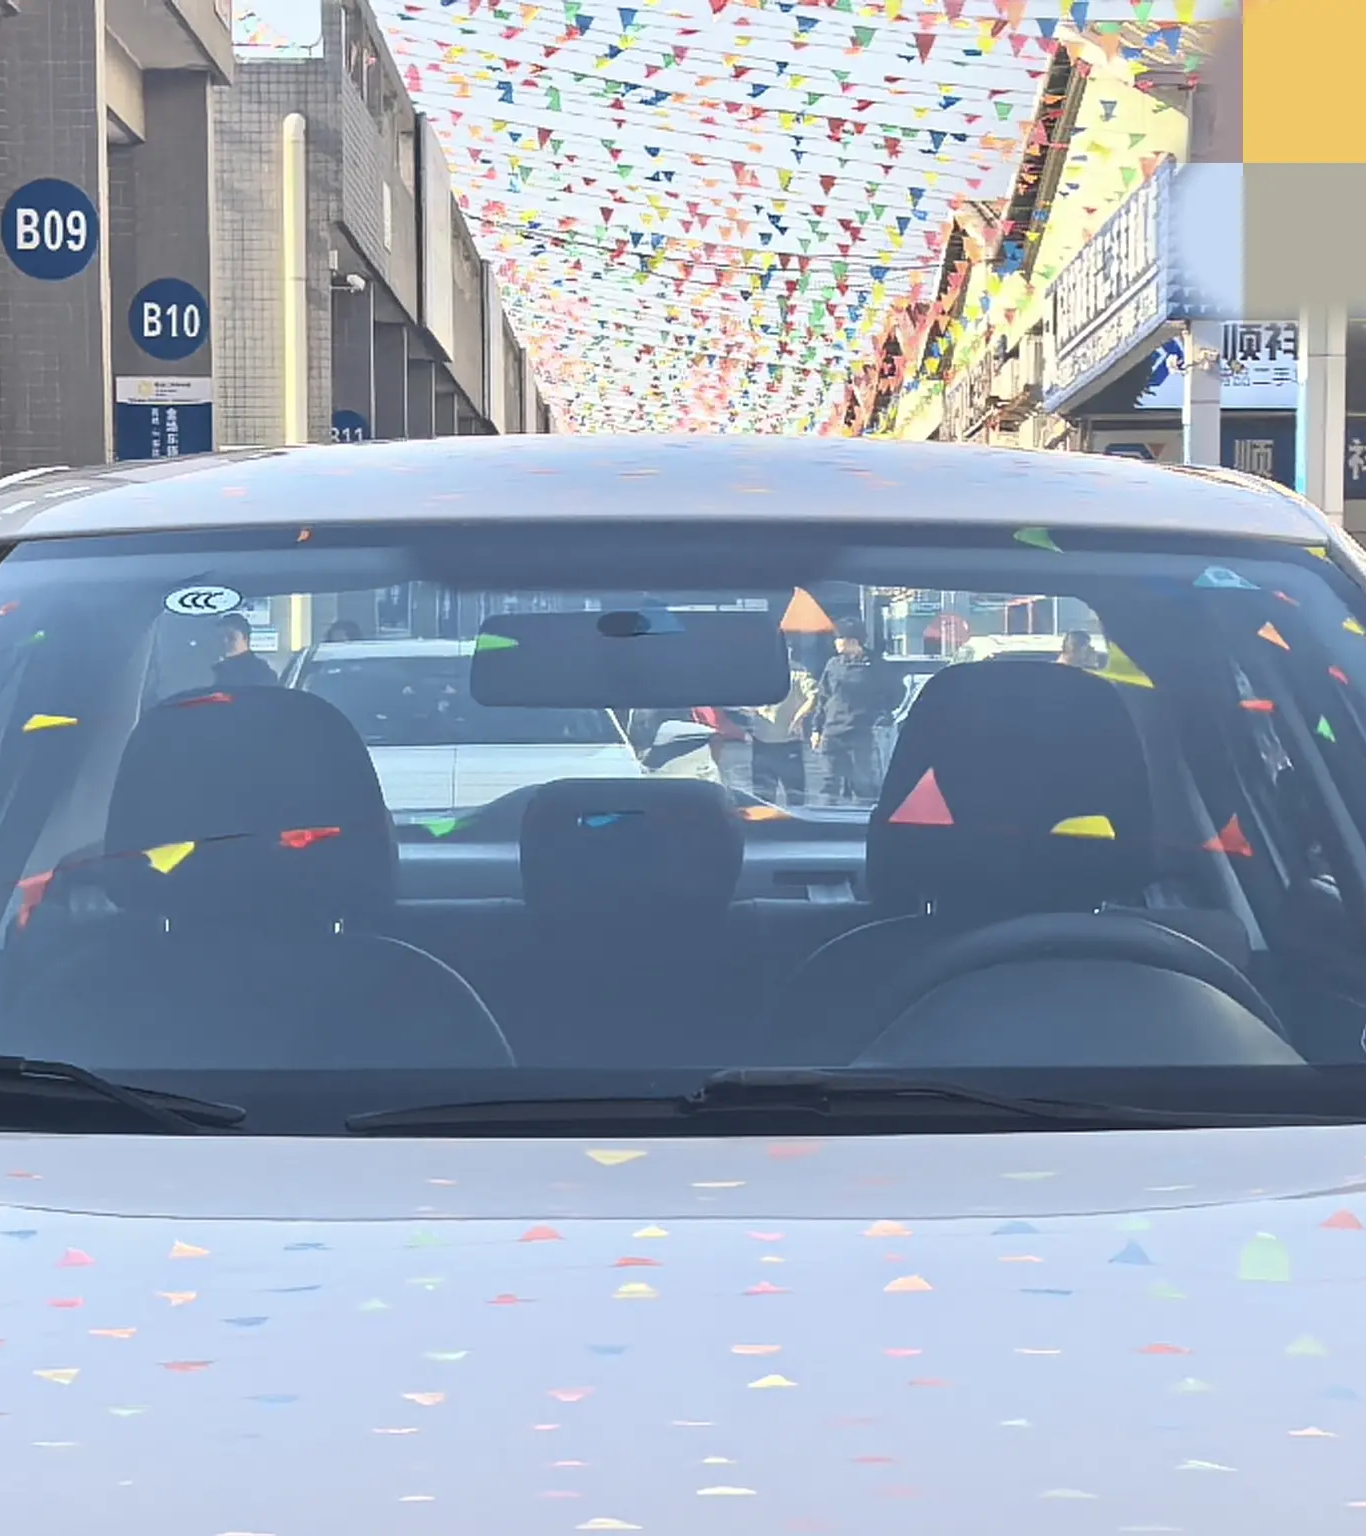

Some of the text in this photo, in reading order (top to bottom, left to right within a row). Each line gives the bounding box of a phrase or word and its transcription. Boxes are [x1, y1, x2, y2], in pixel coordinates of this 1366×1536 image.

[15, 208, 88, 253] B09
[142, 301, 201, 339] B10
[1234, 439, 1274, 477] 顺
